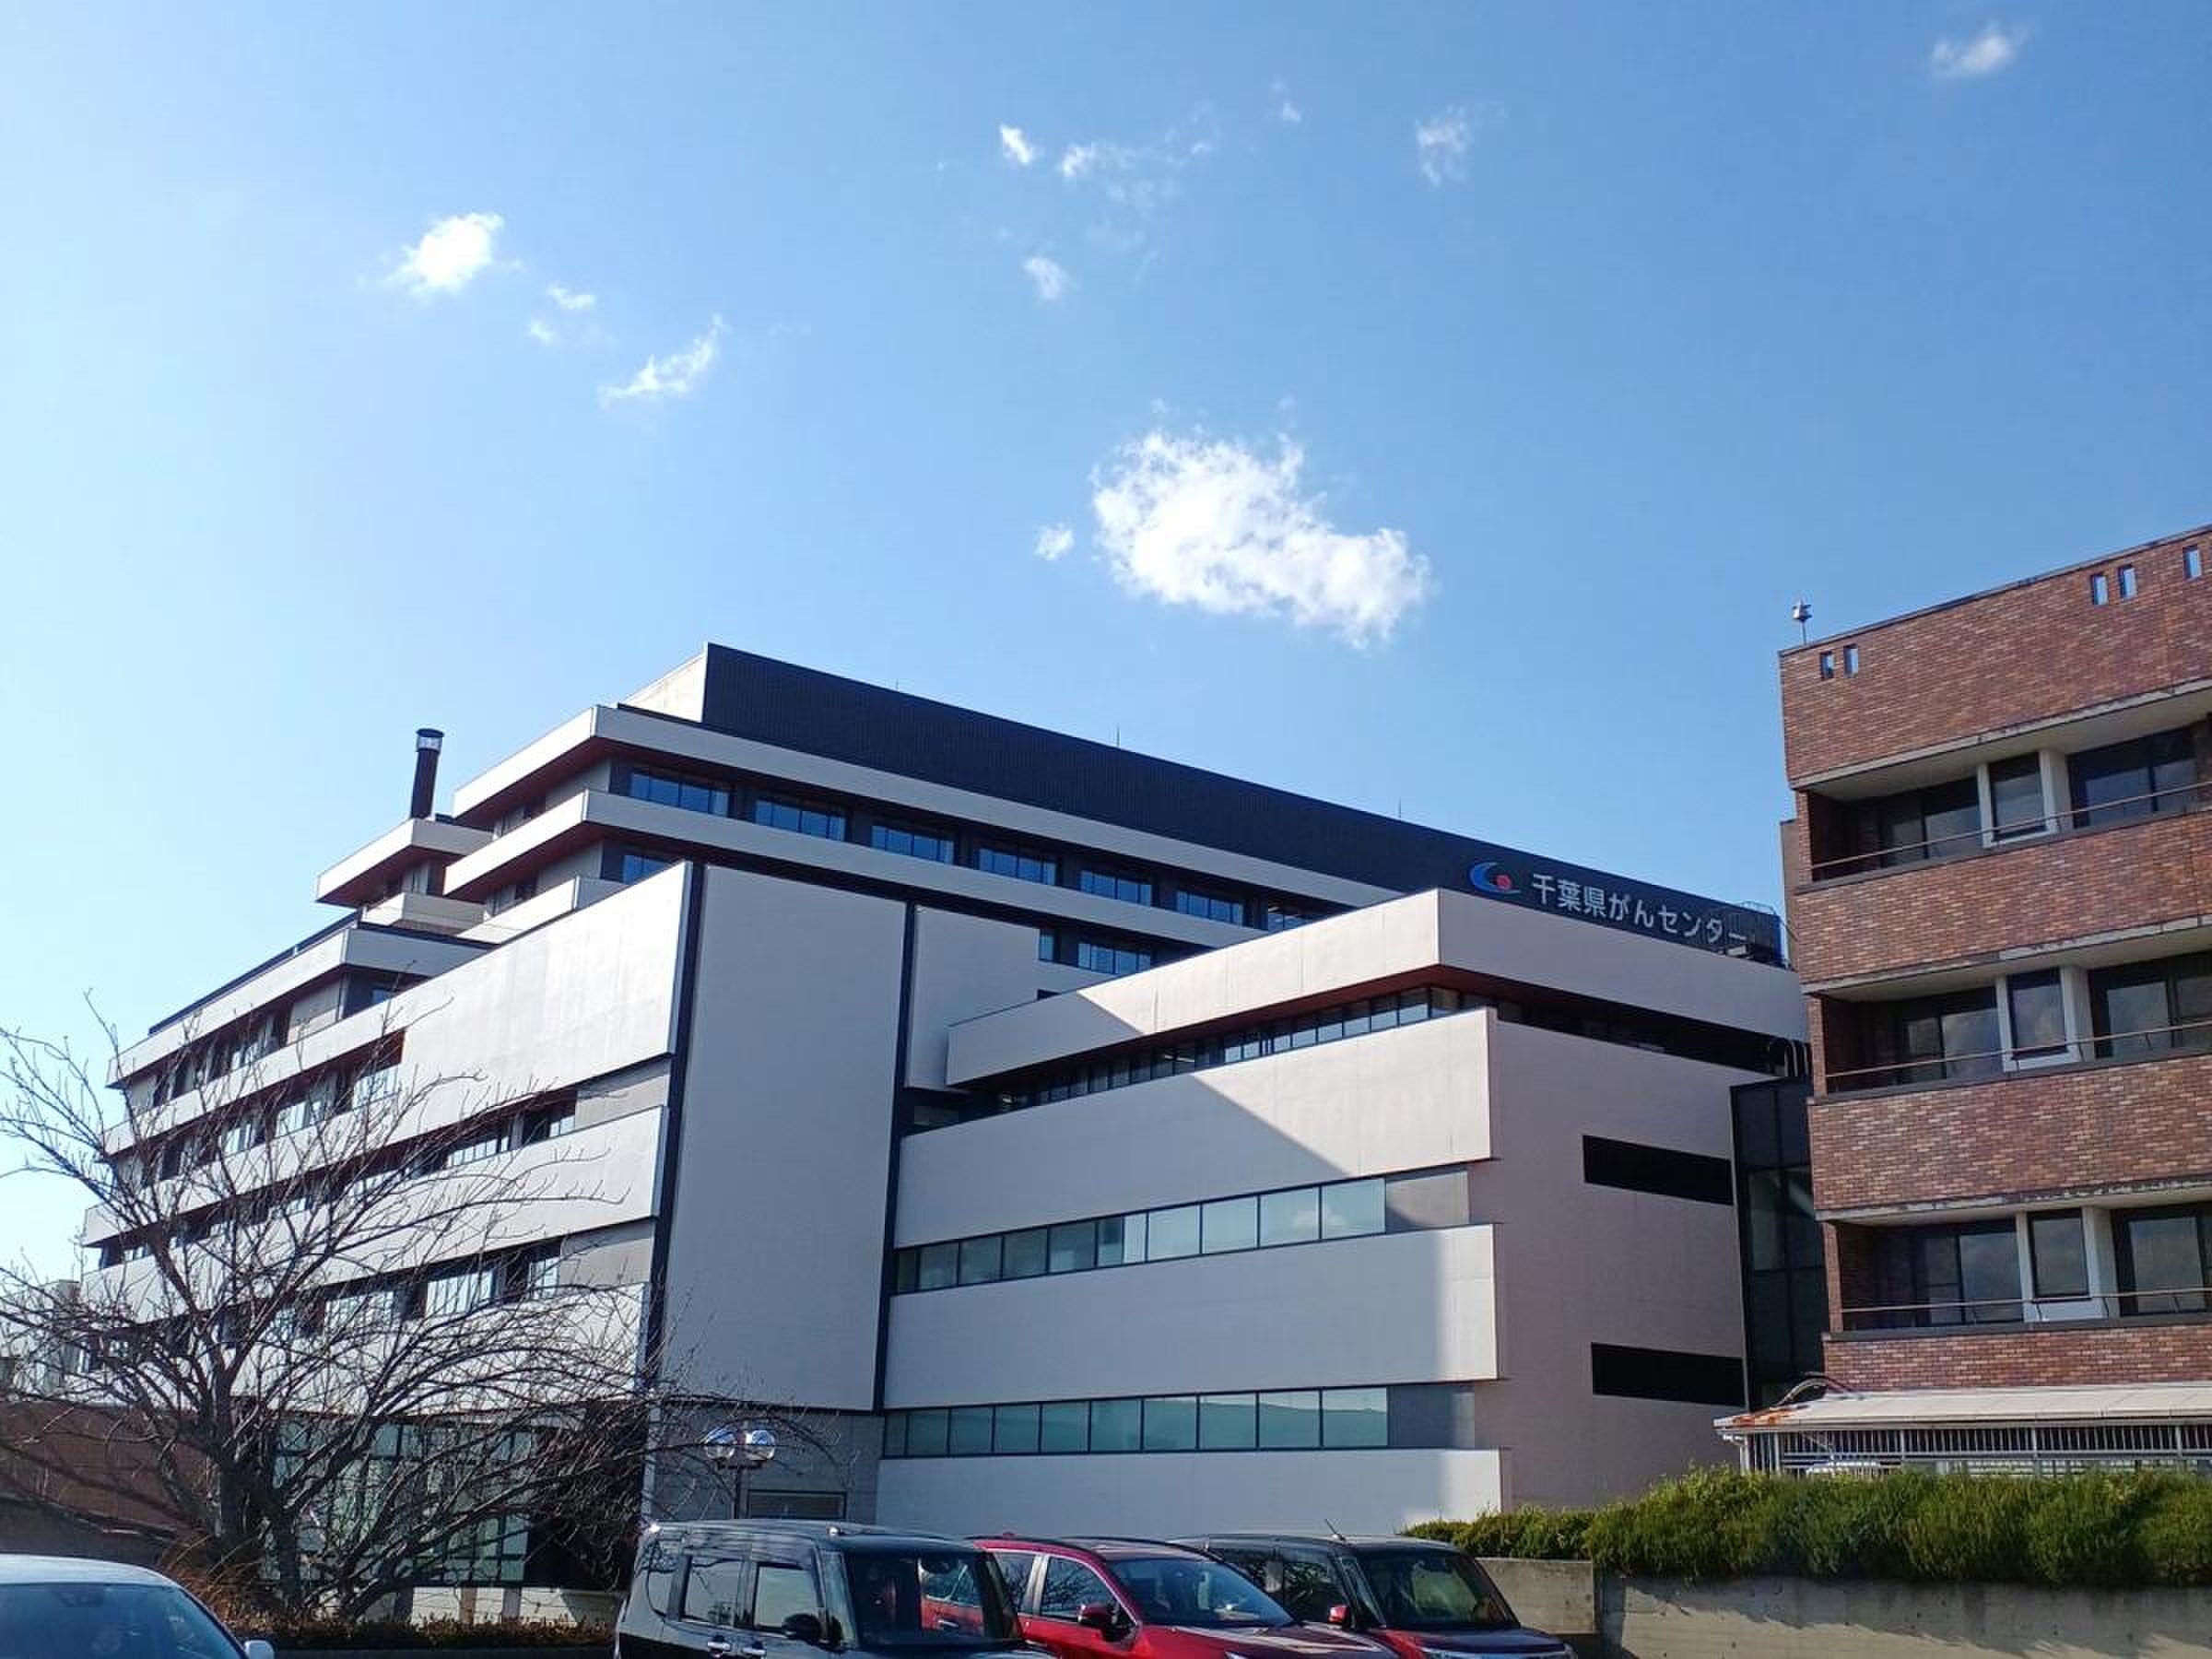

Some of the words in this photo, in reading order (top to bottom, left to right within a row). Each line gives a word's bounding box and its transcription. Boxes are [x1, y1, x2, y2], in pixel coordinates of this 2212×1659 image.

[1532, 873, 1747, 944] 千葉県がんセンター
